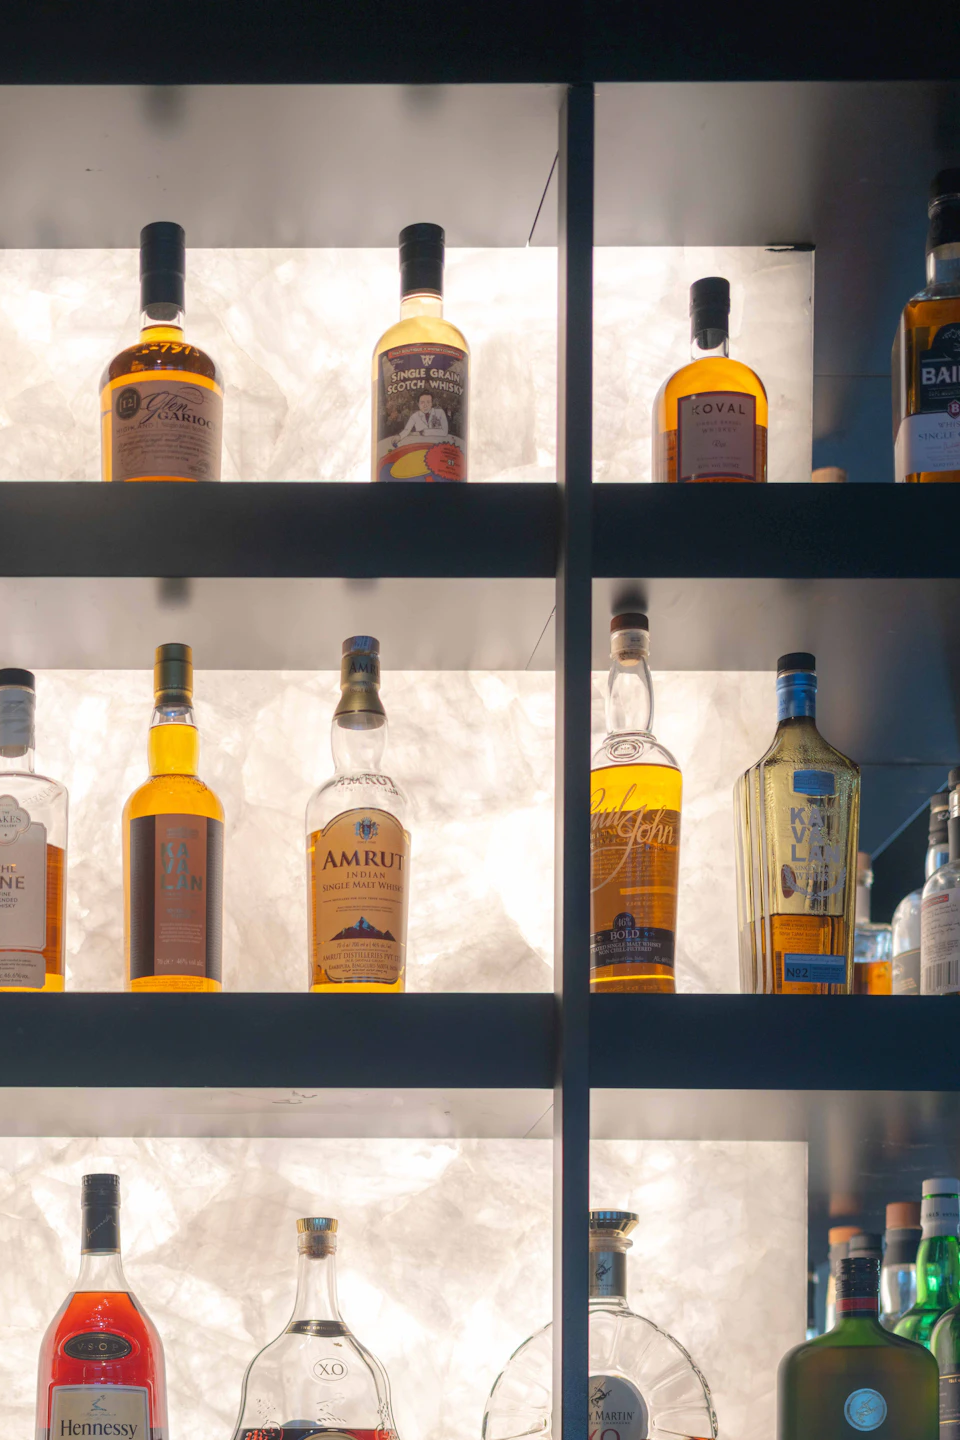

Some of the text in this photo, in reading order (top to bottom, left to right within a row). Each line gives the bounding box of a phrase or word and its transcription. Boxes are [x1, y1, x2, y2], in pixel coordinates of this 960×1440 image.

[391, 368, 460, 382] SINGLE GRAIN
[387, 380, 463, 396] SCOTCH WHISKY
[141, 391, 193, 425] Glen
[691, 402, 746, 415] KOVAL
[790, 806, 825, 826] KA
[791, 826, 826, 844] VA
[160, 842, 190, 859] KA
[790, 844, 840, 864] LAN
[322, 850, 406, 871] AMRUT
[346, 872, 386, 880] INDIAN
[322, 881, 374, 893] SINGLE MALT
[610, 930, 639, 941] BOLD
[344, 952, 384, 960] DISTILLERIES
[596, 1410, 632, 1421] MARTIN
[60, 1420, 138, 1440] Hennessy
